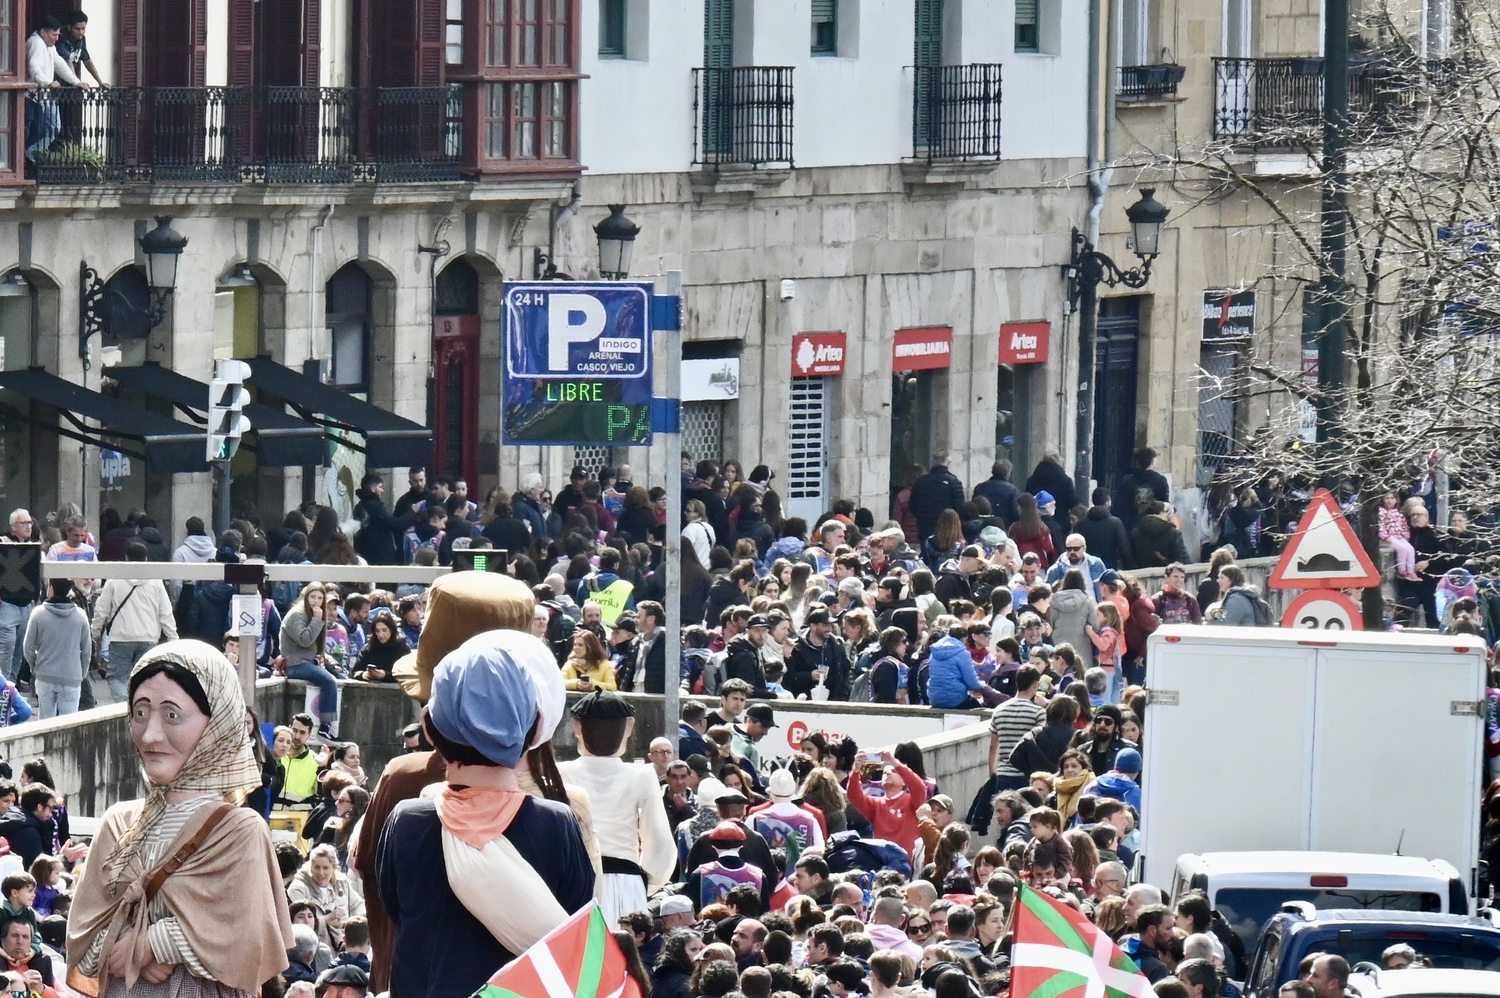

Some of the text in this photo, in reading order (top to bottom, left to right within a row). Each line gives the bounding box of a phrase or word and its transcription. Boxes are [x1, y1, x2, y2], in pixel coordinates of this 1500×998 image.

[515, 293, 544, 305] 24 H
[548, 293, 607, 371] P
[602, 340, 638, 350] INDIGO
[588, 352, 624, 361] ARENAL
[577, 362, 635, 372] CASCO VIEJO
[546, 382, 603, 402] LIBRE
[100, 456, 132, 485] upla
